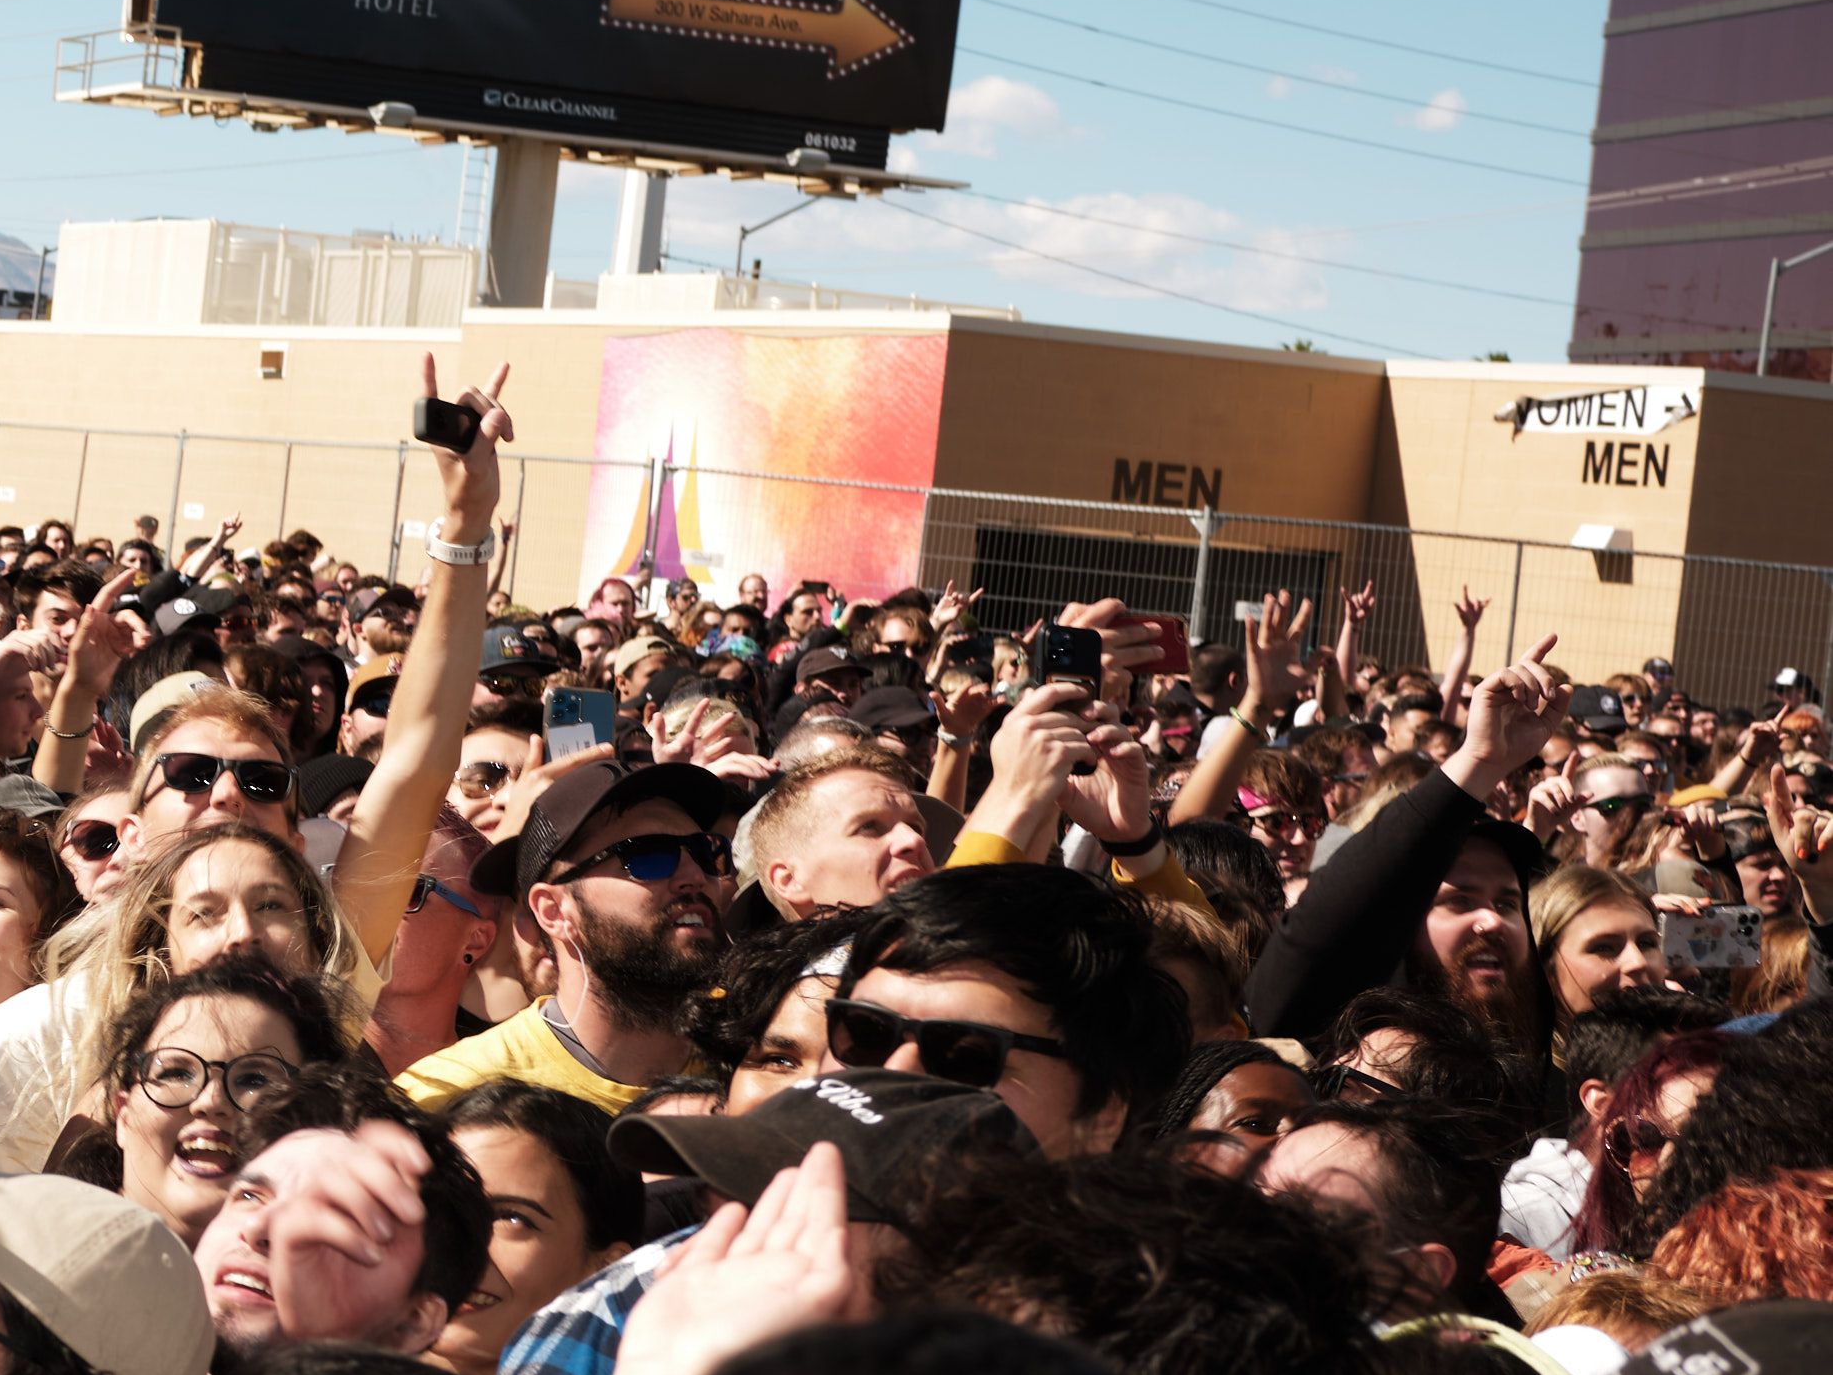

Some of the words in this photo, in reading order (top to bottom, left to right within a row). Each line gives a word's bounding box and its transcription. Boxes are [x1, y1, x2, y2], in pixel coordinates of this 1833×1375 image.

[688, 1, 705, 19] W
[709, 4, 766, 29] Sahara
[1111, 457, 1223, 513] MEN
[1582, 440, 1671, 488] MEN
[815, 1078, 884, 1125] Vibes
